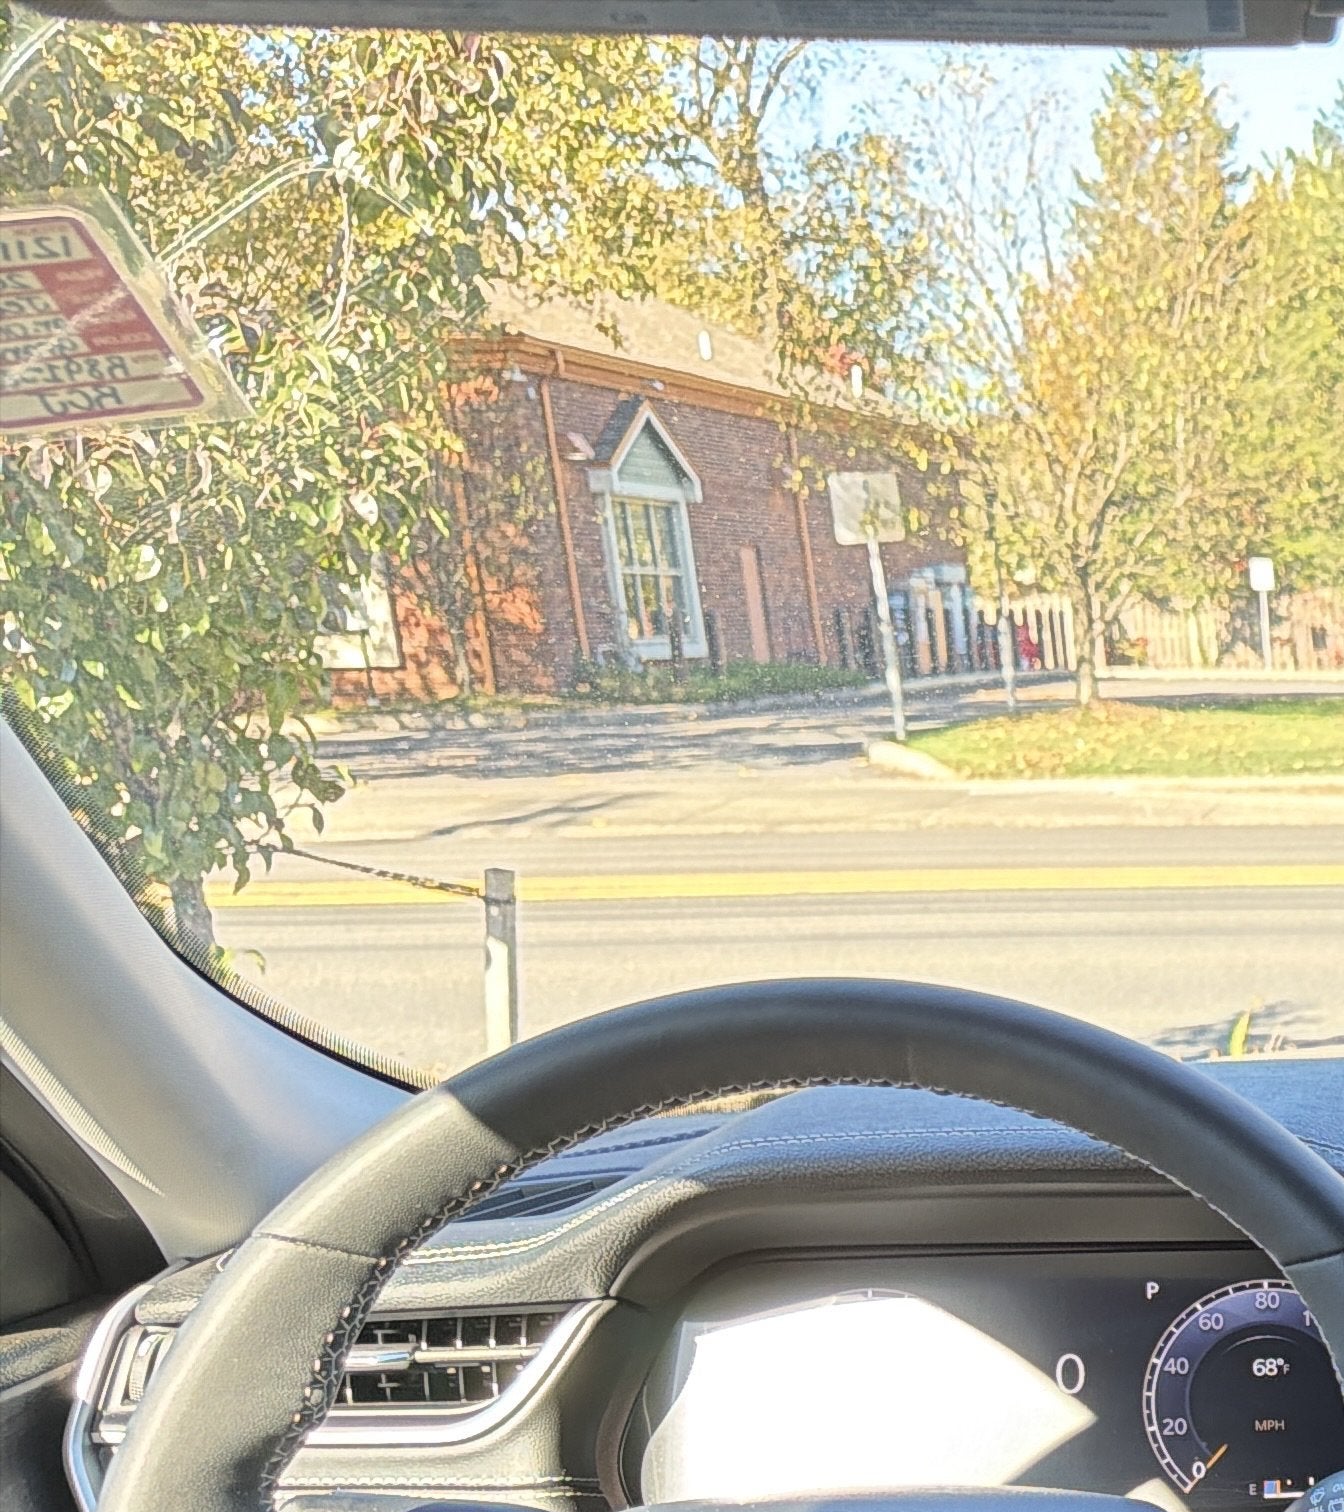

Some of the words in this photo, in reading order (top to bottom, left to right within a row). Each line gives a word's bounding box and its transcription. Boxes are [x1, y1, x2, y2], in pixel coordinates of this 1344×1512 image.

[1146, 1282, 1159, 1299] P
[1255, 1292, 1280, 1309] 80
[1199, 1313, 1223, 1330] 60
[1056, 1353, 1085, 1394] 0
[1163, 1358, 1189, 1375] 40
[1163, 1418, 1187, 1436] 20
[1255, 1420, 1285, 1431] MPH
[1192, 1461, 1206, 1479] 0
[1249, 1484, 1257, 1496] E
